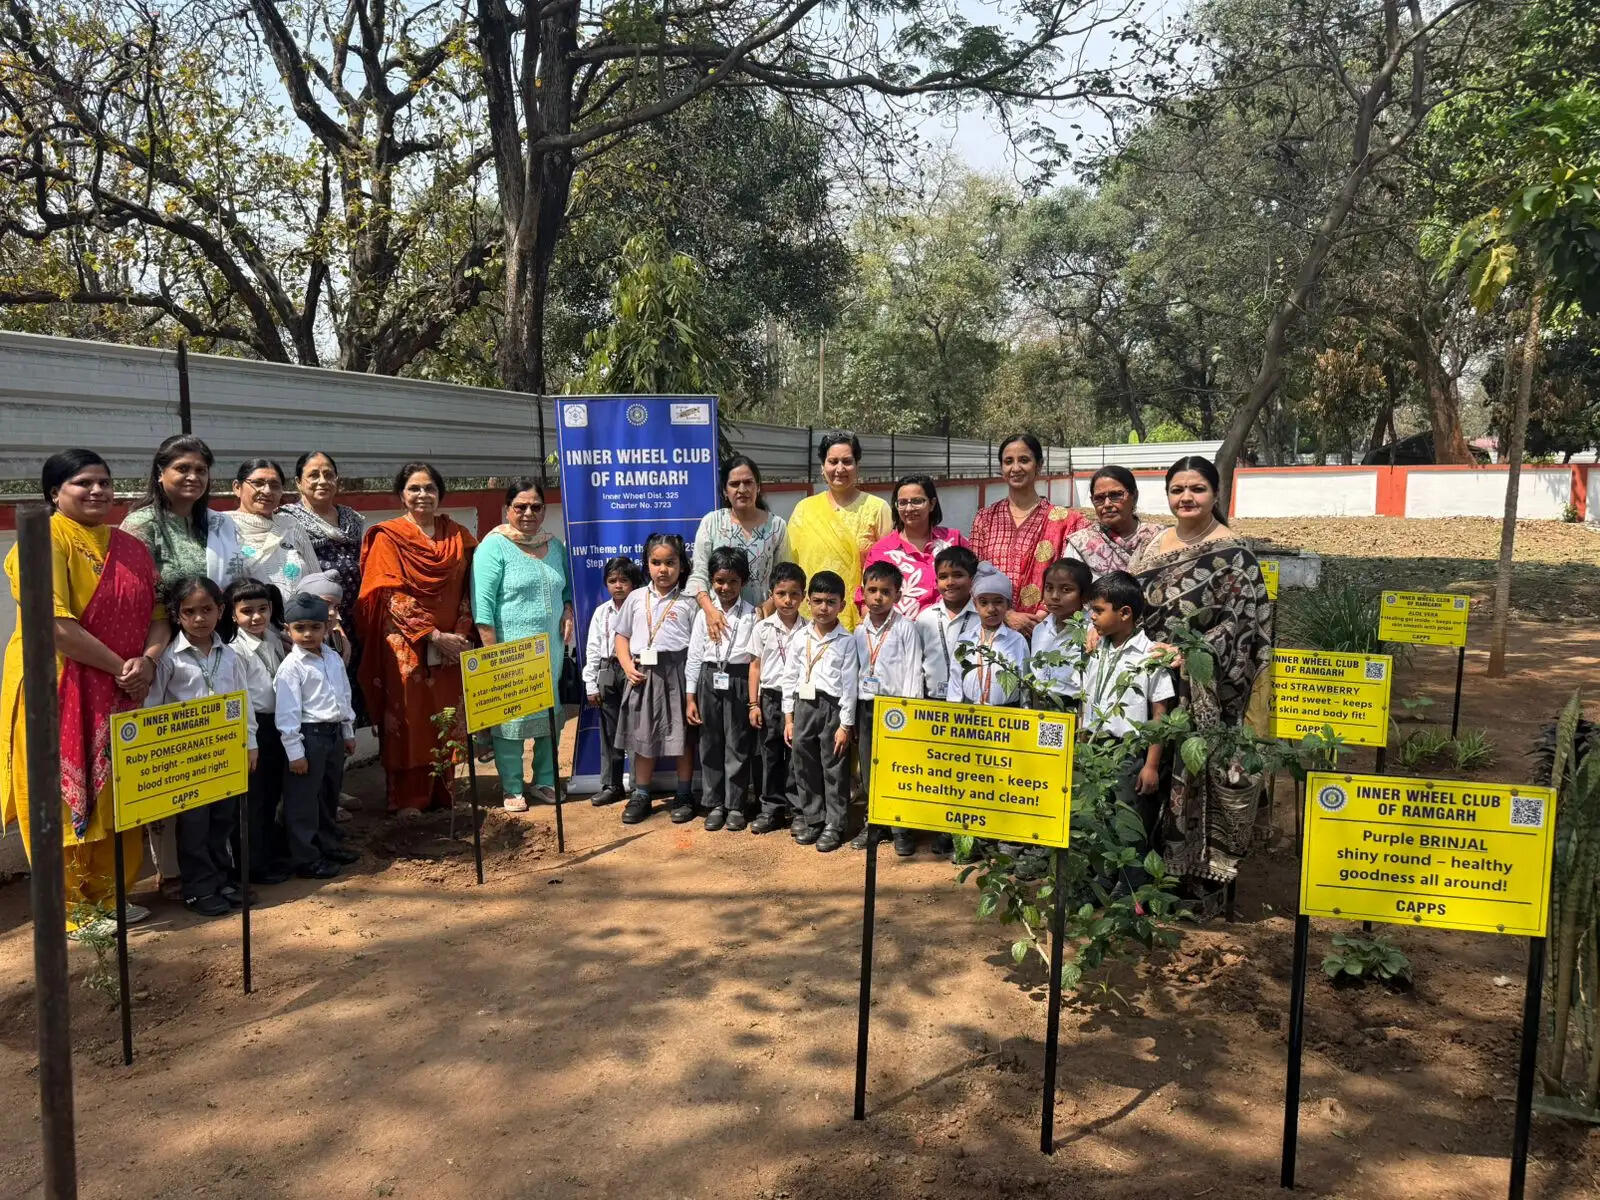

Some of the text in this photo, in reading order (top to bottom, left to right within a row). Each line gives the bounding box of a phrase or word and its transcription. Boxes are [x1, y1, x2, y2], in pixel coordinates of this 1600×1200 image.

[567, 448, 710, 465] INNER WHEEL CLUB
[591, 471, 688, 487] OF RAMGARH
[590, 545, 617, 554] Theme
[620, 544, 631, 553] for
[635, 544, 644, 553] th
[586, 559, 603, 568] Step
[481, 643, 531, 660] INNER WHEEL CLUB
[500, 653, 524, 664] RAMGARH
[1272, 655, 1359, 668] INNER WHEEL CLUB
[493, 668, 524, 681] STARFRUIT
[1285, 665, 1344, 676] OF RAMGARH
[478, 680, 511, 696] star-shaped
[504, 689, 517, 699] fresh
[519, 686, 528, 694] and
[530, 682, 543, 691] light!
[1290, 683, 1360, 695] STRAWBERRY
[504, 704, 521, 715] CAPPS
[1302, 697, 1331, 705] sweet
[1343, 699, 1372, 708] keeps
[143, 703, 221, 727] INNER WHEEL CLUB
[914, 709, 1030, 731] INNER WHEEL CLUB
[1280, 706, 1299, 714] skin
[1323, 710, 1348, 719] body
[1352, 711, 1366, 719] fit!
[157, 716, 209, 736] OF RAMGARH
[931, 725, 1010, 743] OF RAMGARH
[126, 731, 236, 765] Ruby POMEGRANATE Seeds
[141, 768, 149, 776] so
[152, 760, 177, 774] bright
[187, 751, 211, 764] makes
[213, 749, 225, 757] our
[927, 749, 1012, 768] Sacred TULSI
[138, 760, 229, 792] blood strong and right!
[892, 762, 923, 775] fresh
[928, 767, 952, 778] and
[956, 771, 994, 783] green
[1008, 775, 1049, 790] keeps
[172, 789, 199, 805] CAPPS
[898, 781, 1039, 806] us healthy and clean!
[1357, 786, 1500, 807] INNER WHEEL CLUB
[946, 812, 986, 826] CAPPS
[1378, 803, 1476, 822] OF RAMGARH
[1363, 830, 1488, 851] Purple BRINJAL
[1337, 848, 1378, 864] shiny
[1383, 851, 1431, 866] round
[1451, 856, 1513, 875] healthy
[1339, 868, 1507, 892] goodness all around!
[1396, 900, 1446, 916] CAPPS
